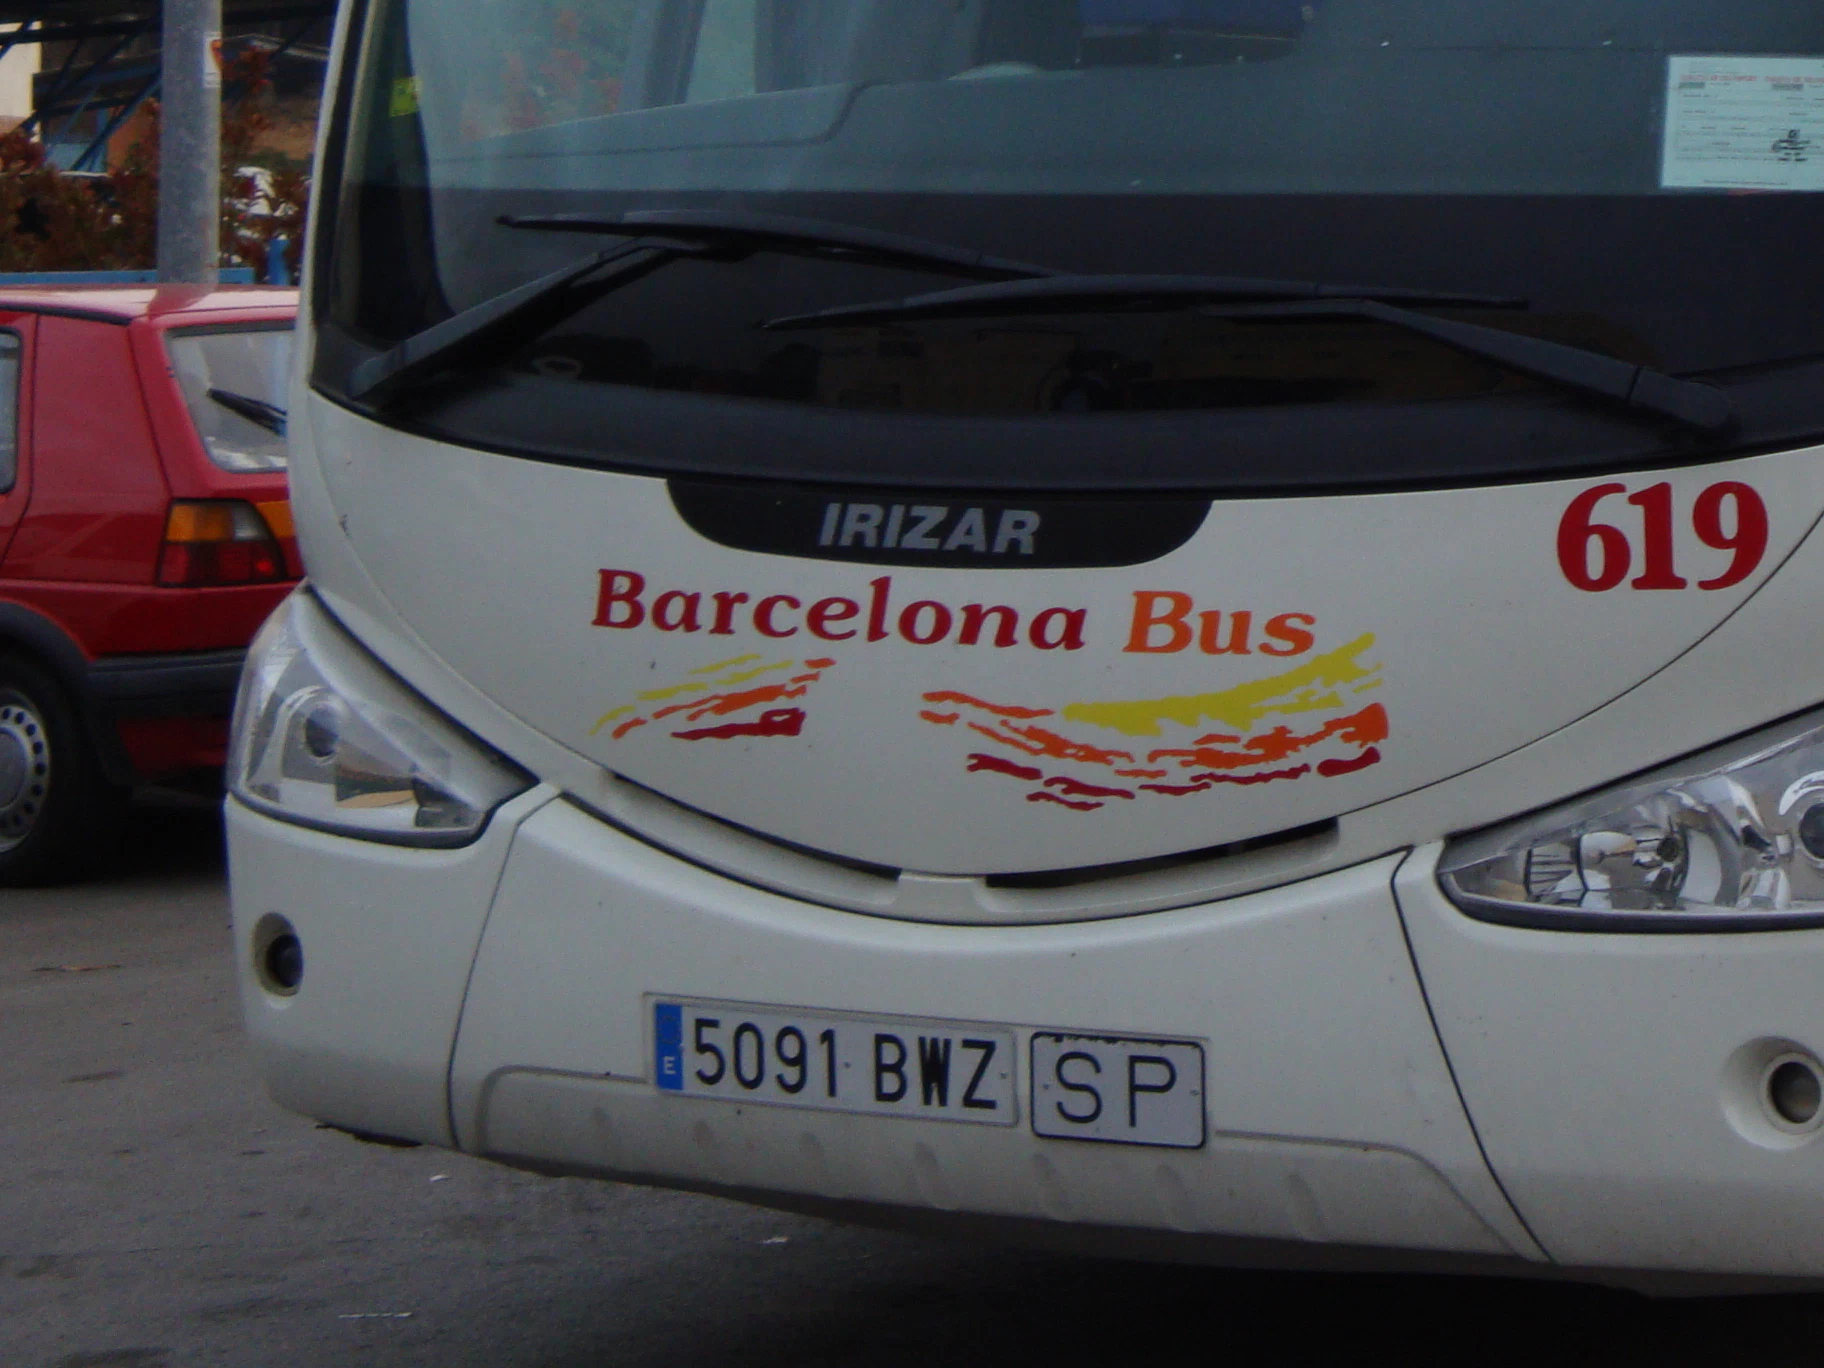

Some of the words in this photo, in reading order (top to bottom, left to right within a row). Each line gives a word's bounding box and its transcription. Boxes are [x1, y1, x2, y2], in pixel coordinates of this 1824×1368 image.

[817, 501, 1042, 555] IRIZAR
[1556, 480, 1769, 593] 619
[590, 567, 1088, 652] Barcelona
[1121, 589, 1318, 658] Bus
[663, 1055, 677, 1076] E
[693, 1017, 837, 1098] 5091
[873, 1032, 998, 1110] BWZ
[1054, 1050, 1177, 1128] SP
